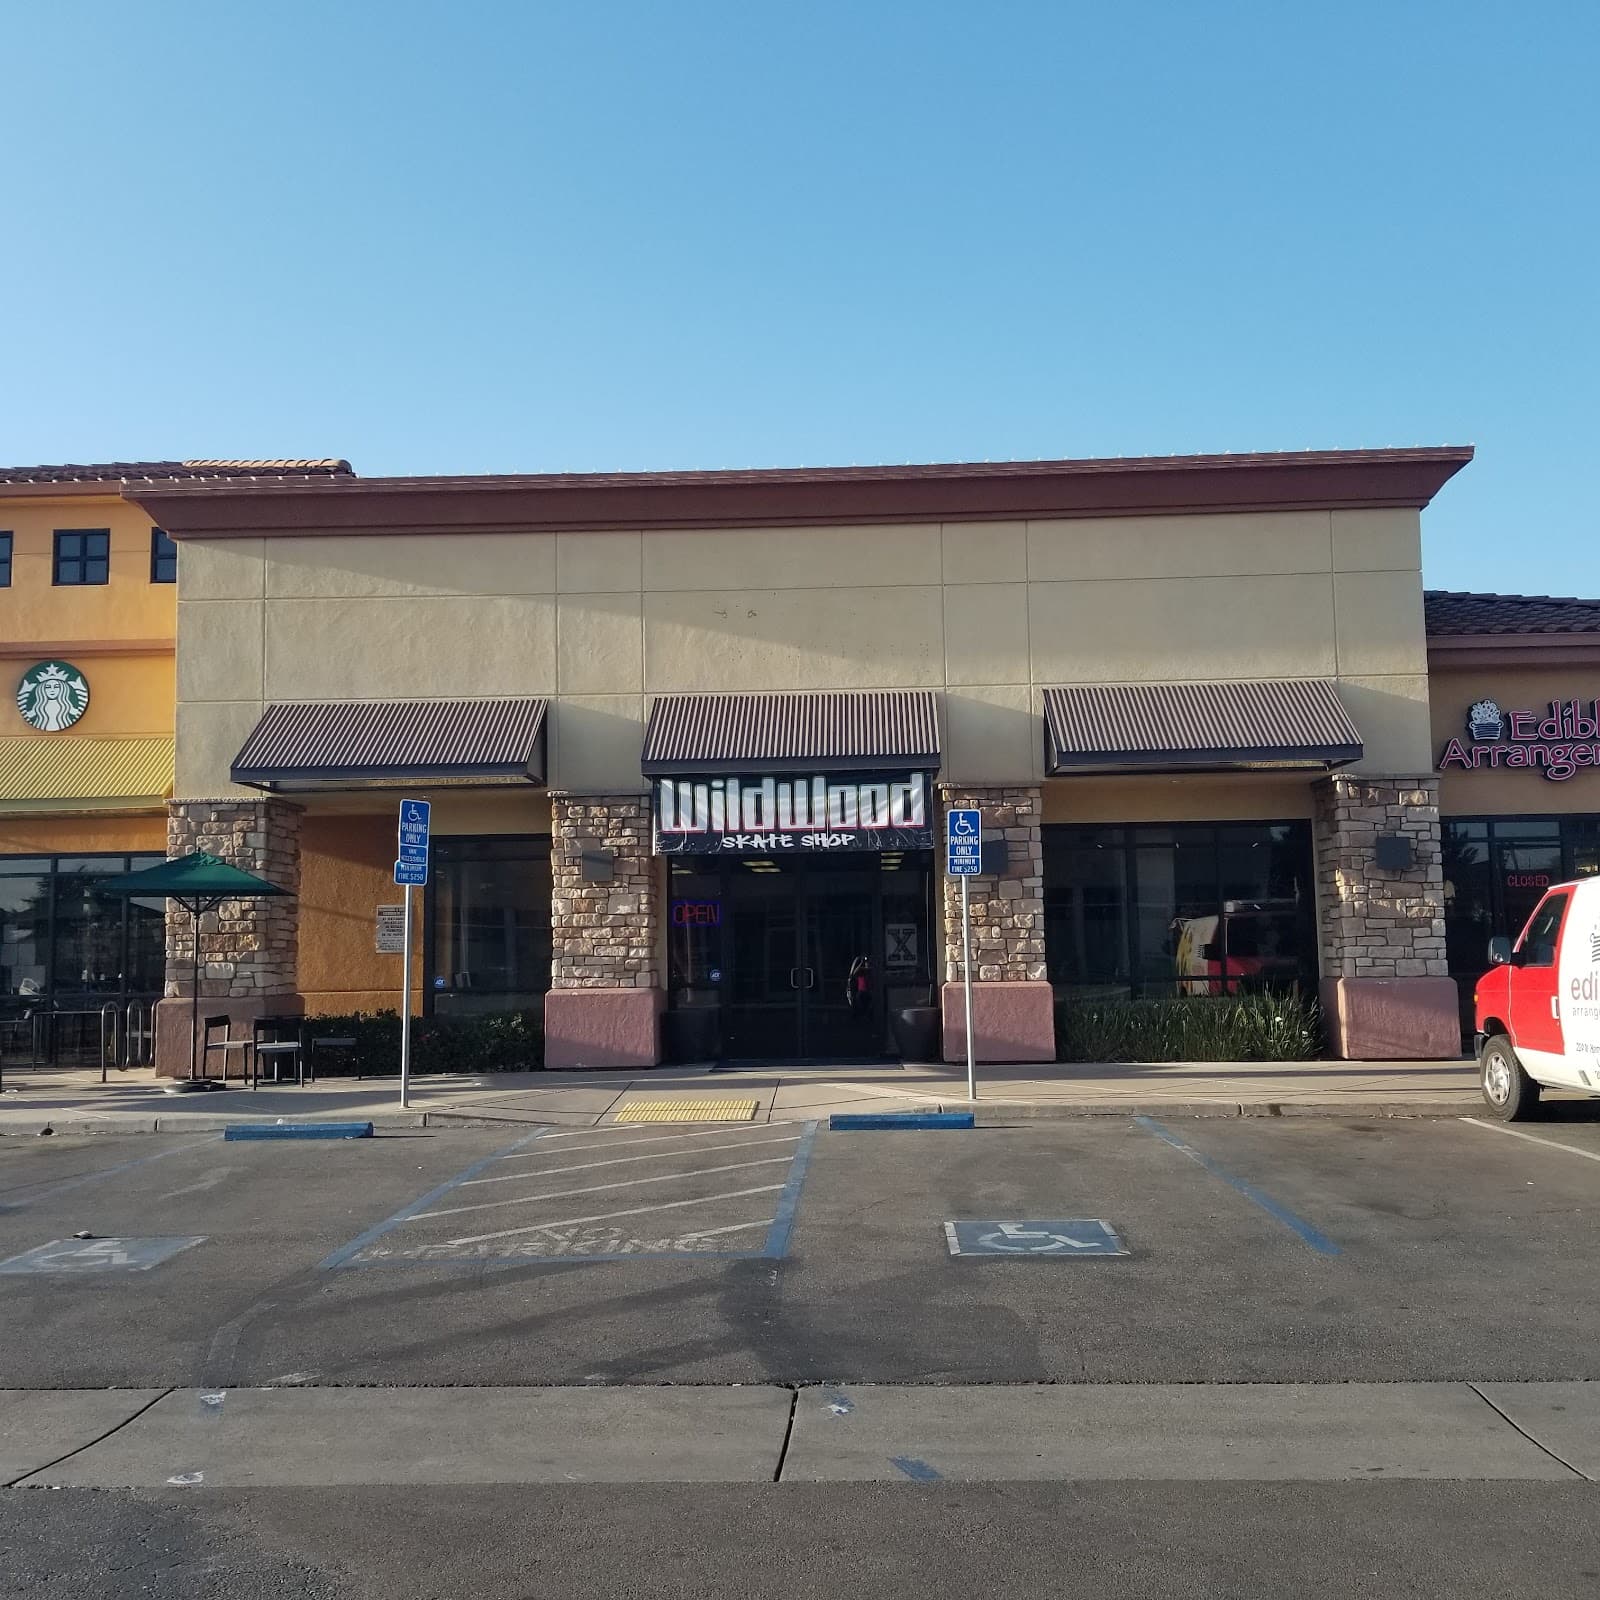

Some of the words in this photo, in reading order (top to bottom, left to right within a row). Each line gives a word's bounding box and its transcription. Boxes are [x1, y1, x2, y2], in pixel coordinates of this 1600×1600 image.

[401, 821, 427, 834] PARKING
[406, 833, 421, 844] ONLY
[722, 833, 795, 850] SKATE
[800, 833, 857, 849] SHOP
[950, 835, 979, 845] PARKING
[956, 846, 973, 855] ONLY
[951, 865, 963, 873] FINE
[963, 865, 978, 873] $250
[410, 873, 424, 881] $250
[1507, 874, 1550, 887] CLOSED
[673, 903, 720, 925] OPEN
[1572, 1007, 1600, 1021] arrang
[538, 1227, 624, 1240] NO
